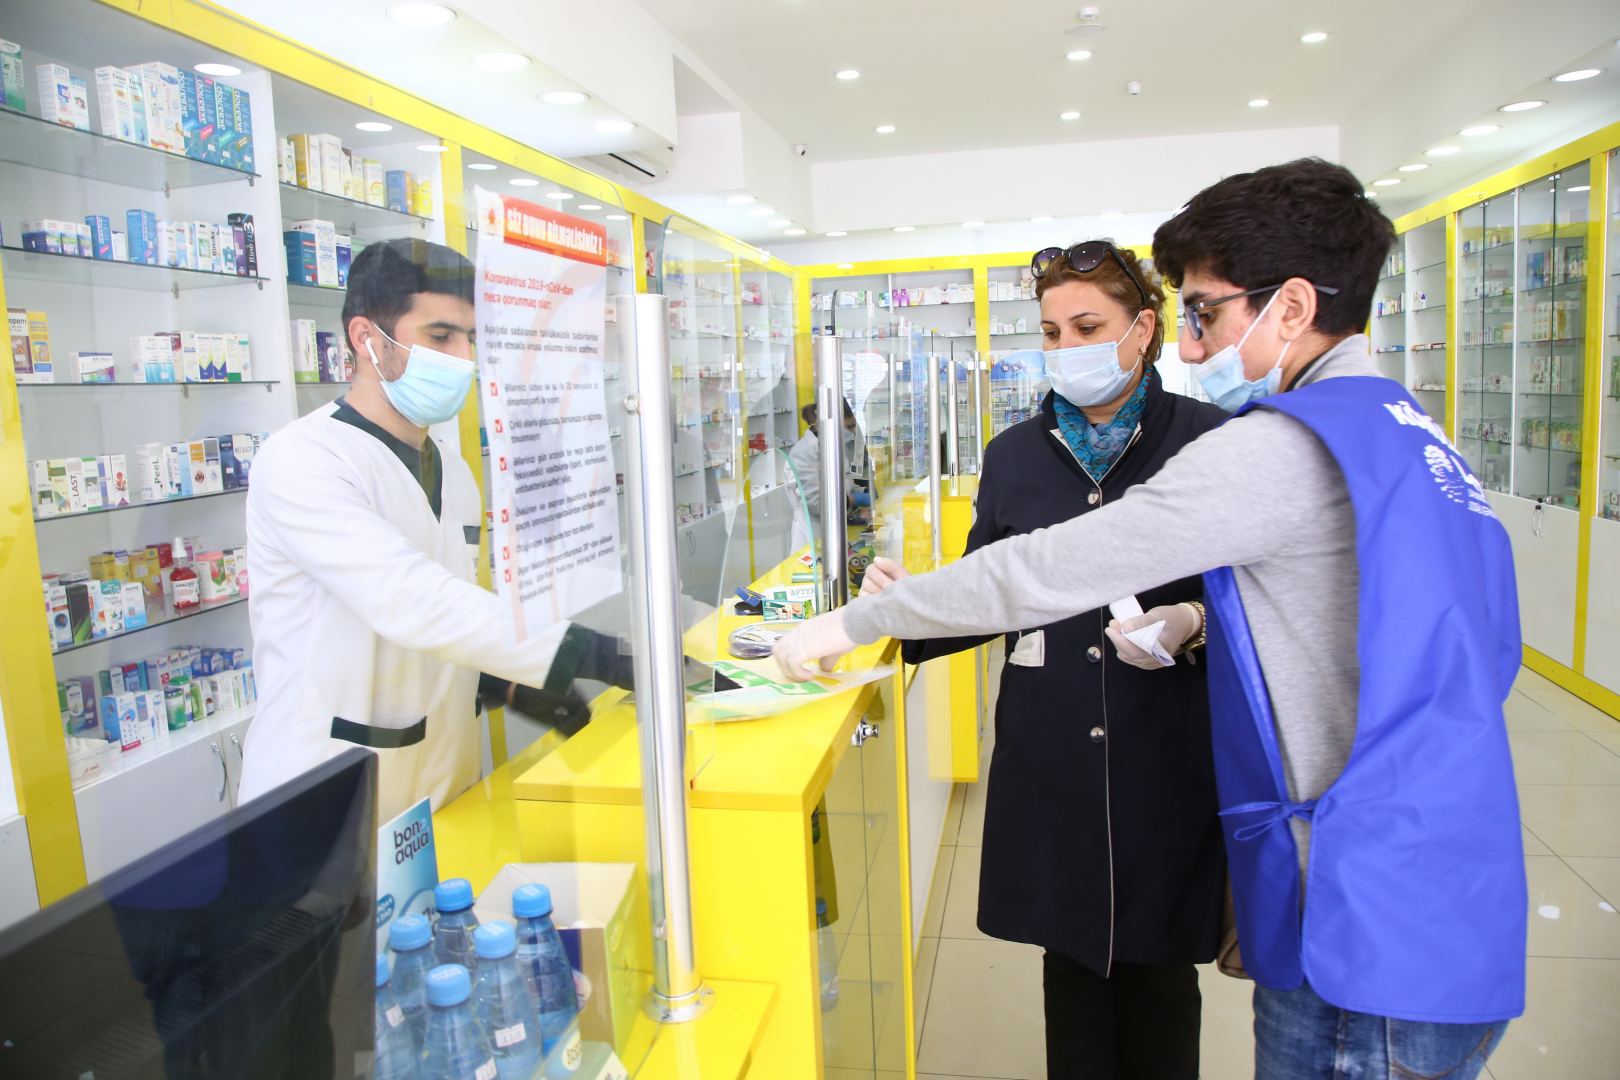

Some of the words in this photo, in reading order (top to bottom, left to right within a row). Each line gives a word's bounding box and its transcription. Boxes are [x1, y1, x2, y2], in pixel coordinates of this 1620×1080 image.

[178, 71, 189, 118] аквалор
[197, 79, 207, 124] аквалор
[216, 86, 226, 130] аквалор
[234, 90, 243, 133] аквалор
[484, 270, 526, 289] Koronavirus
[70, 475, 80, 497] LAST
[395, 832, 430, 866] aqua
